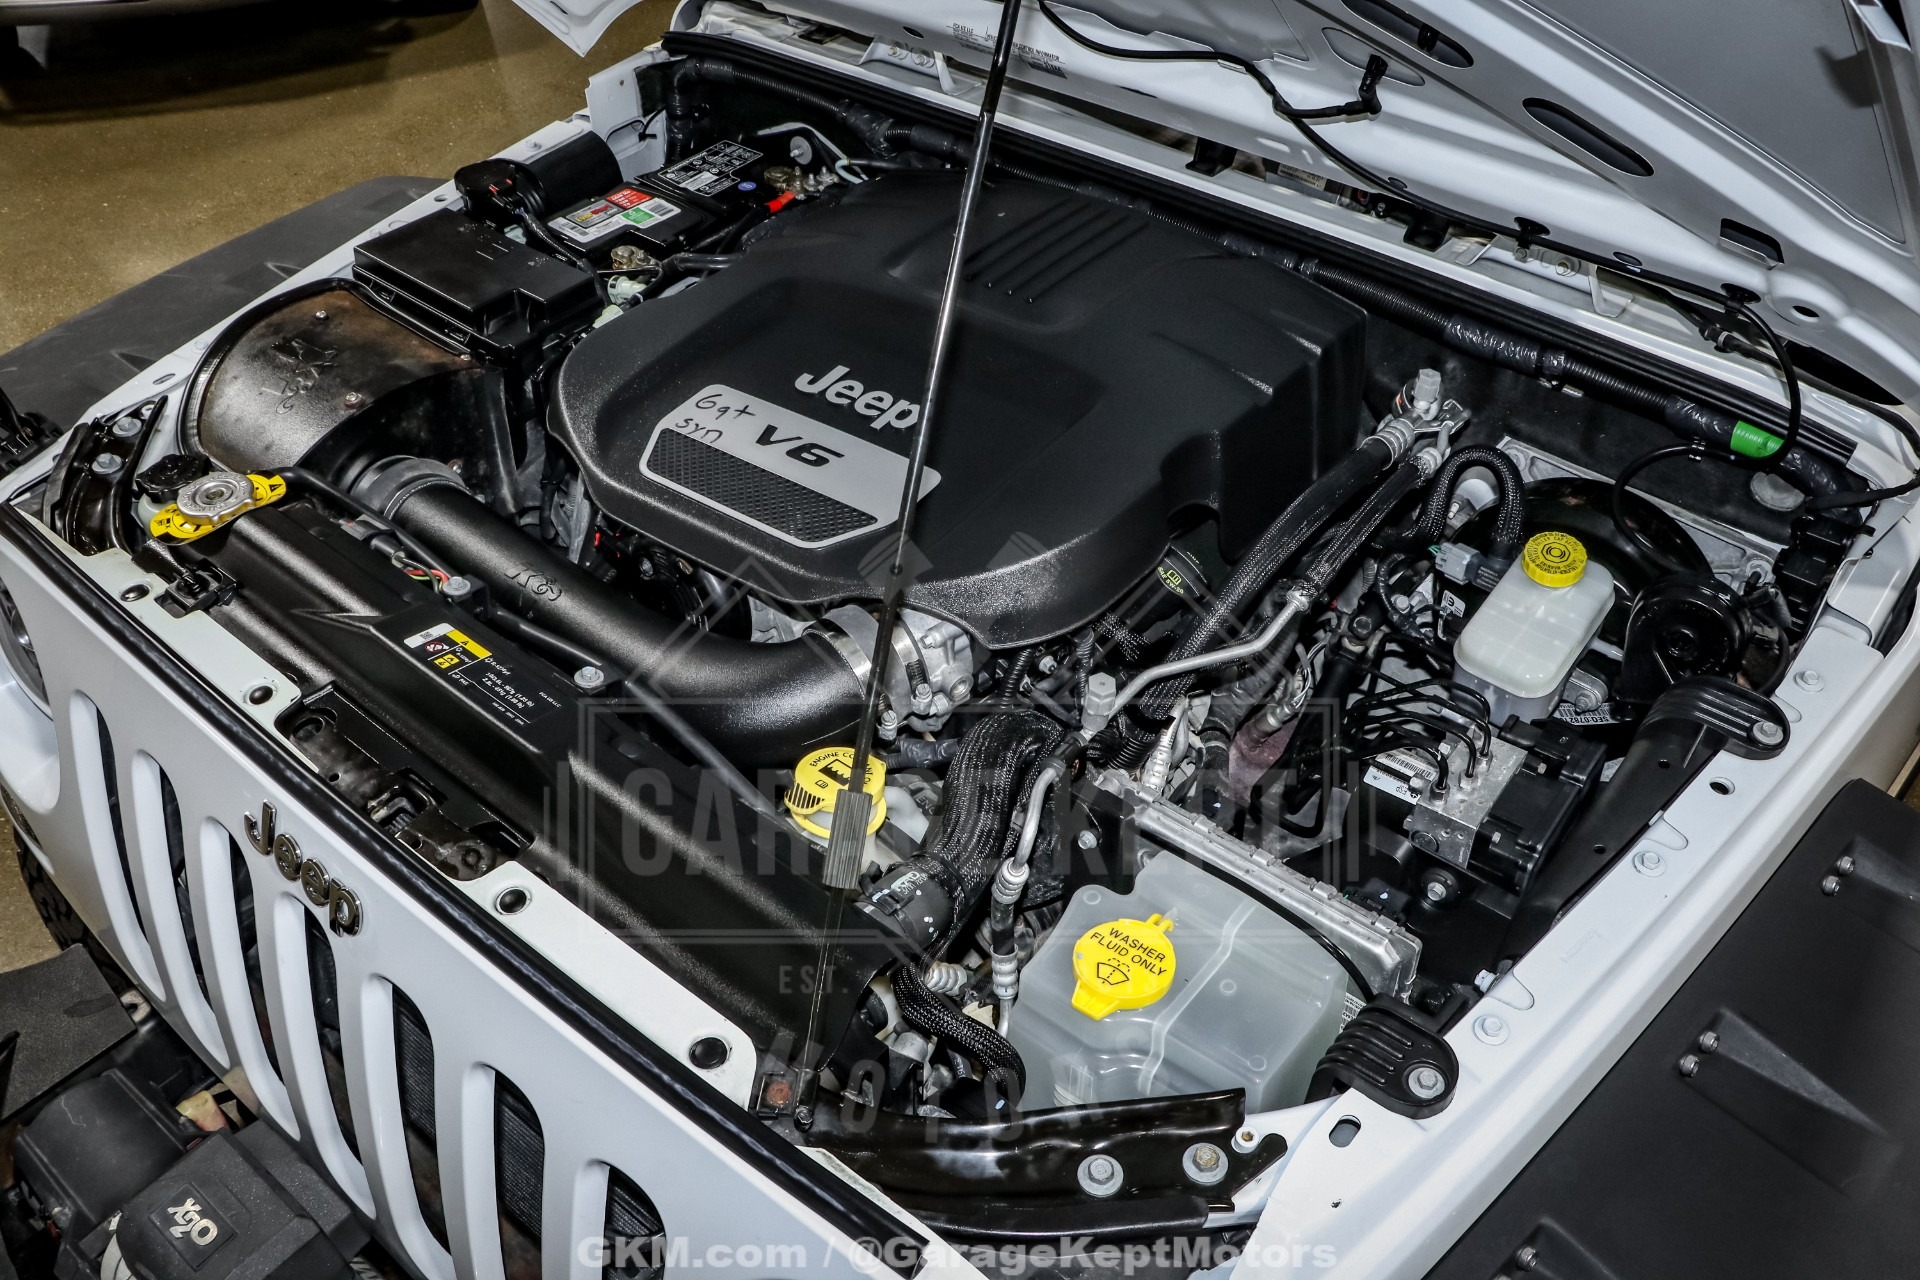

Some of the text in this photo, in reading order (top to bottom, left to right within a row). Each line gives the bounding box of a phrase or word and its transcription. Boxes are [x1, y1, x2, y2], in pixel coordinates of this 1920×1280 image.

[794, 365, 920, 431] Jeep
[755, 423, 845, 467] V6
[810, 751, 840, 767] ENGINE
[243, 799, 364, 938] Jeep
[1090, 932, 1167, 977] FLUID ONLY
[1109, 927, 1166, 963] WASHER
